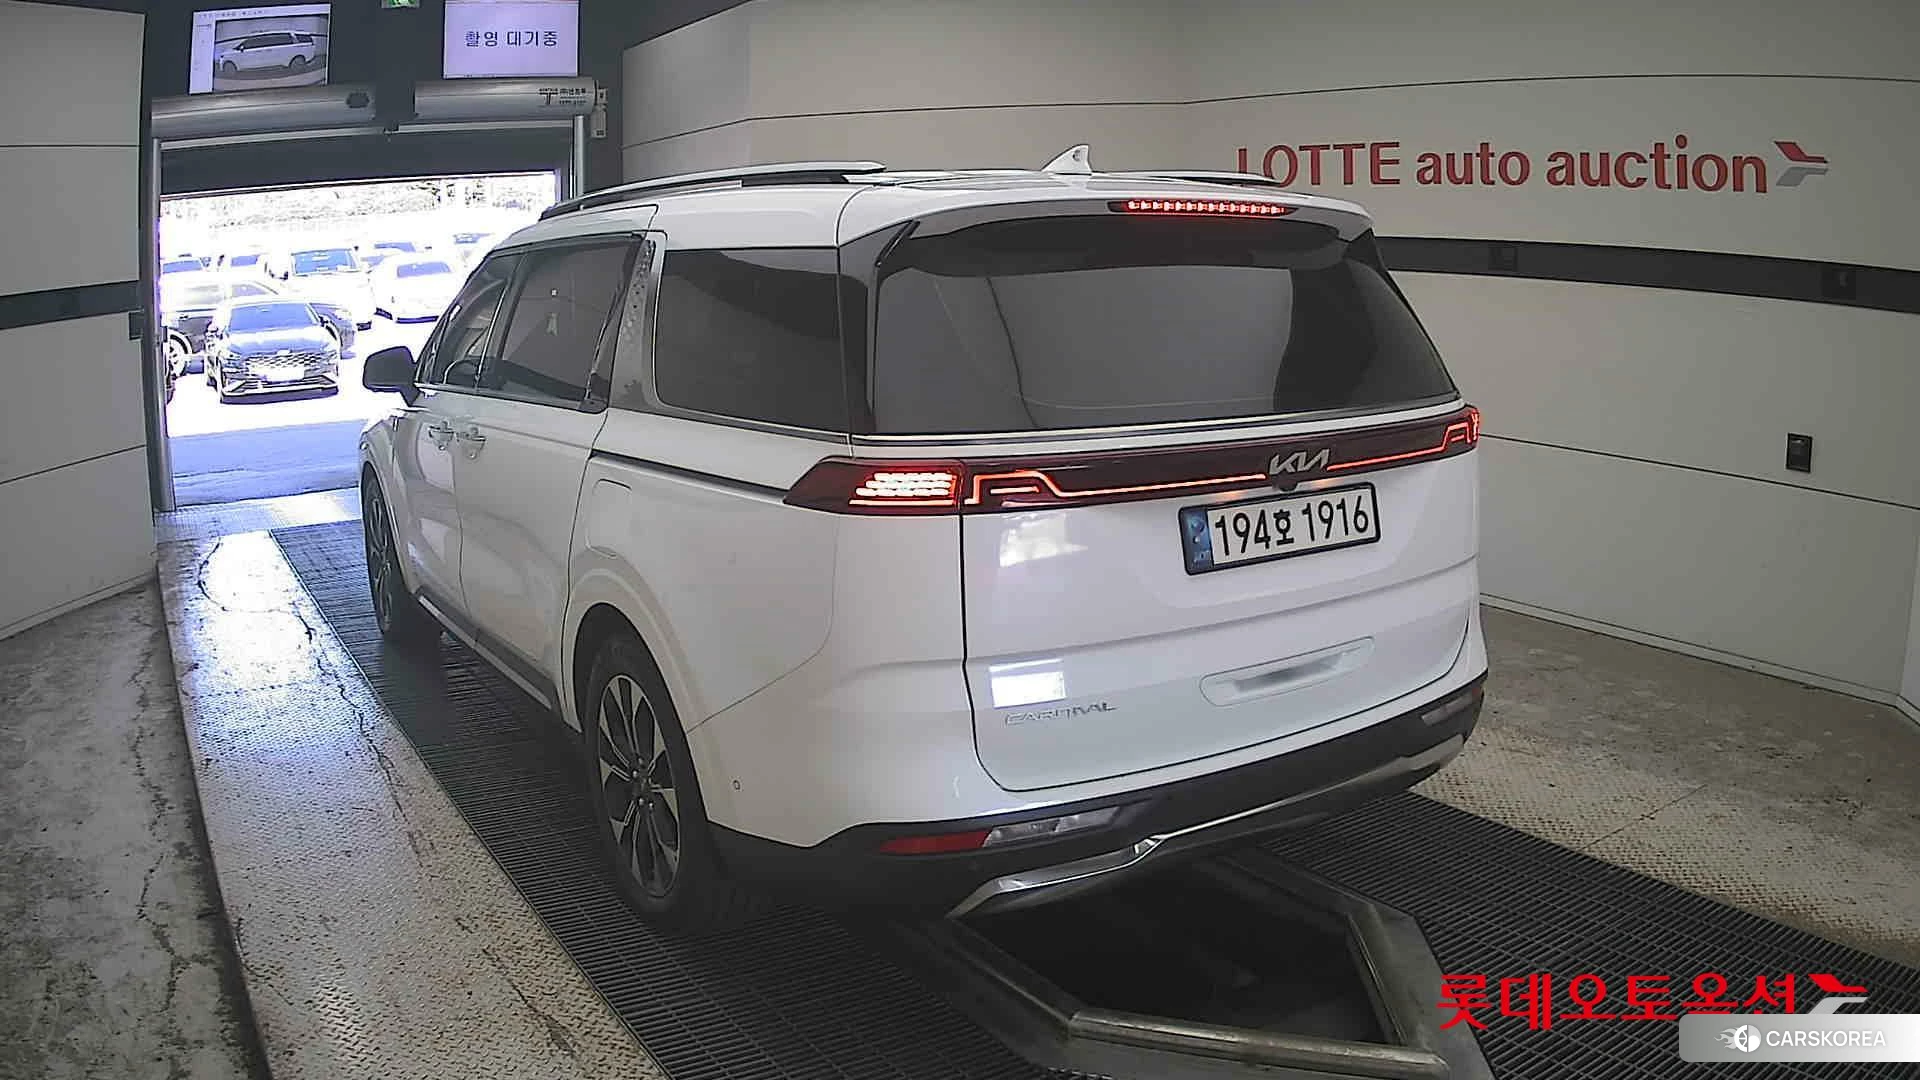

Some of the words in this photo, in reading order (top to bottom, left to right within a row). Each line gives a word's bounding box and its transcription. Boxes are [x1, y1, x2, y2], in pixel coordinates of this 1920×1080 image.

[506, 31, 559, 47] 대기중
[1416, 142, 1530, 185] auto
[1546, 134, 1767, 193] auction
[1269, 449, 1330, 475] KIA
[1215, 509, 1294, 556] 194호
[1301, 495, 1369, 541] 1916
